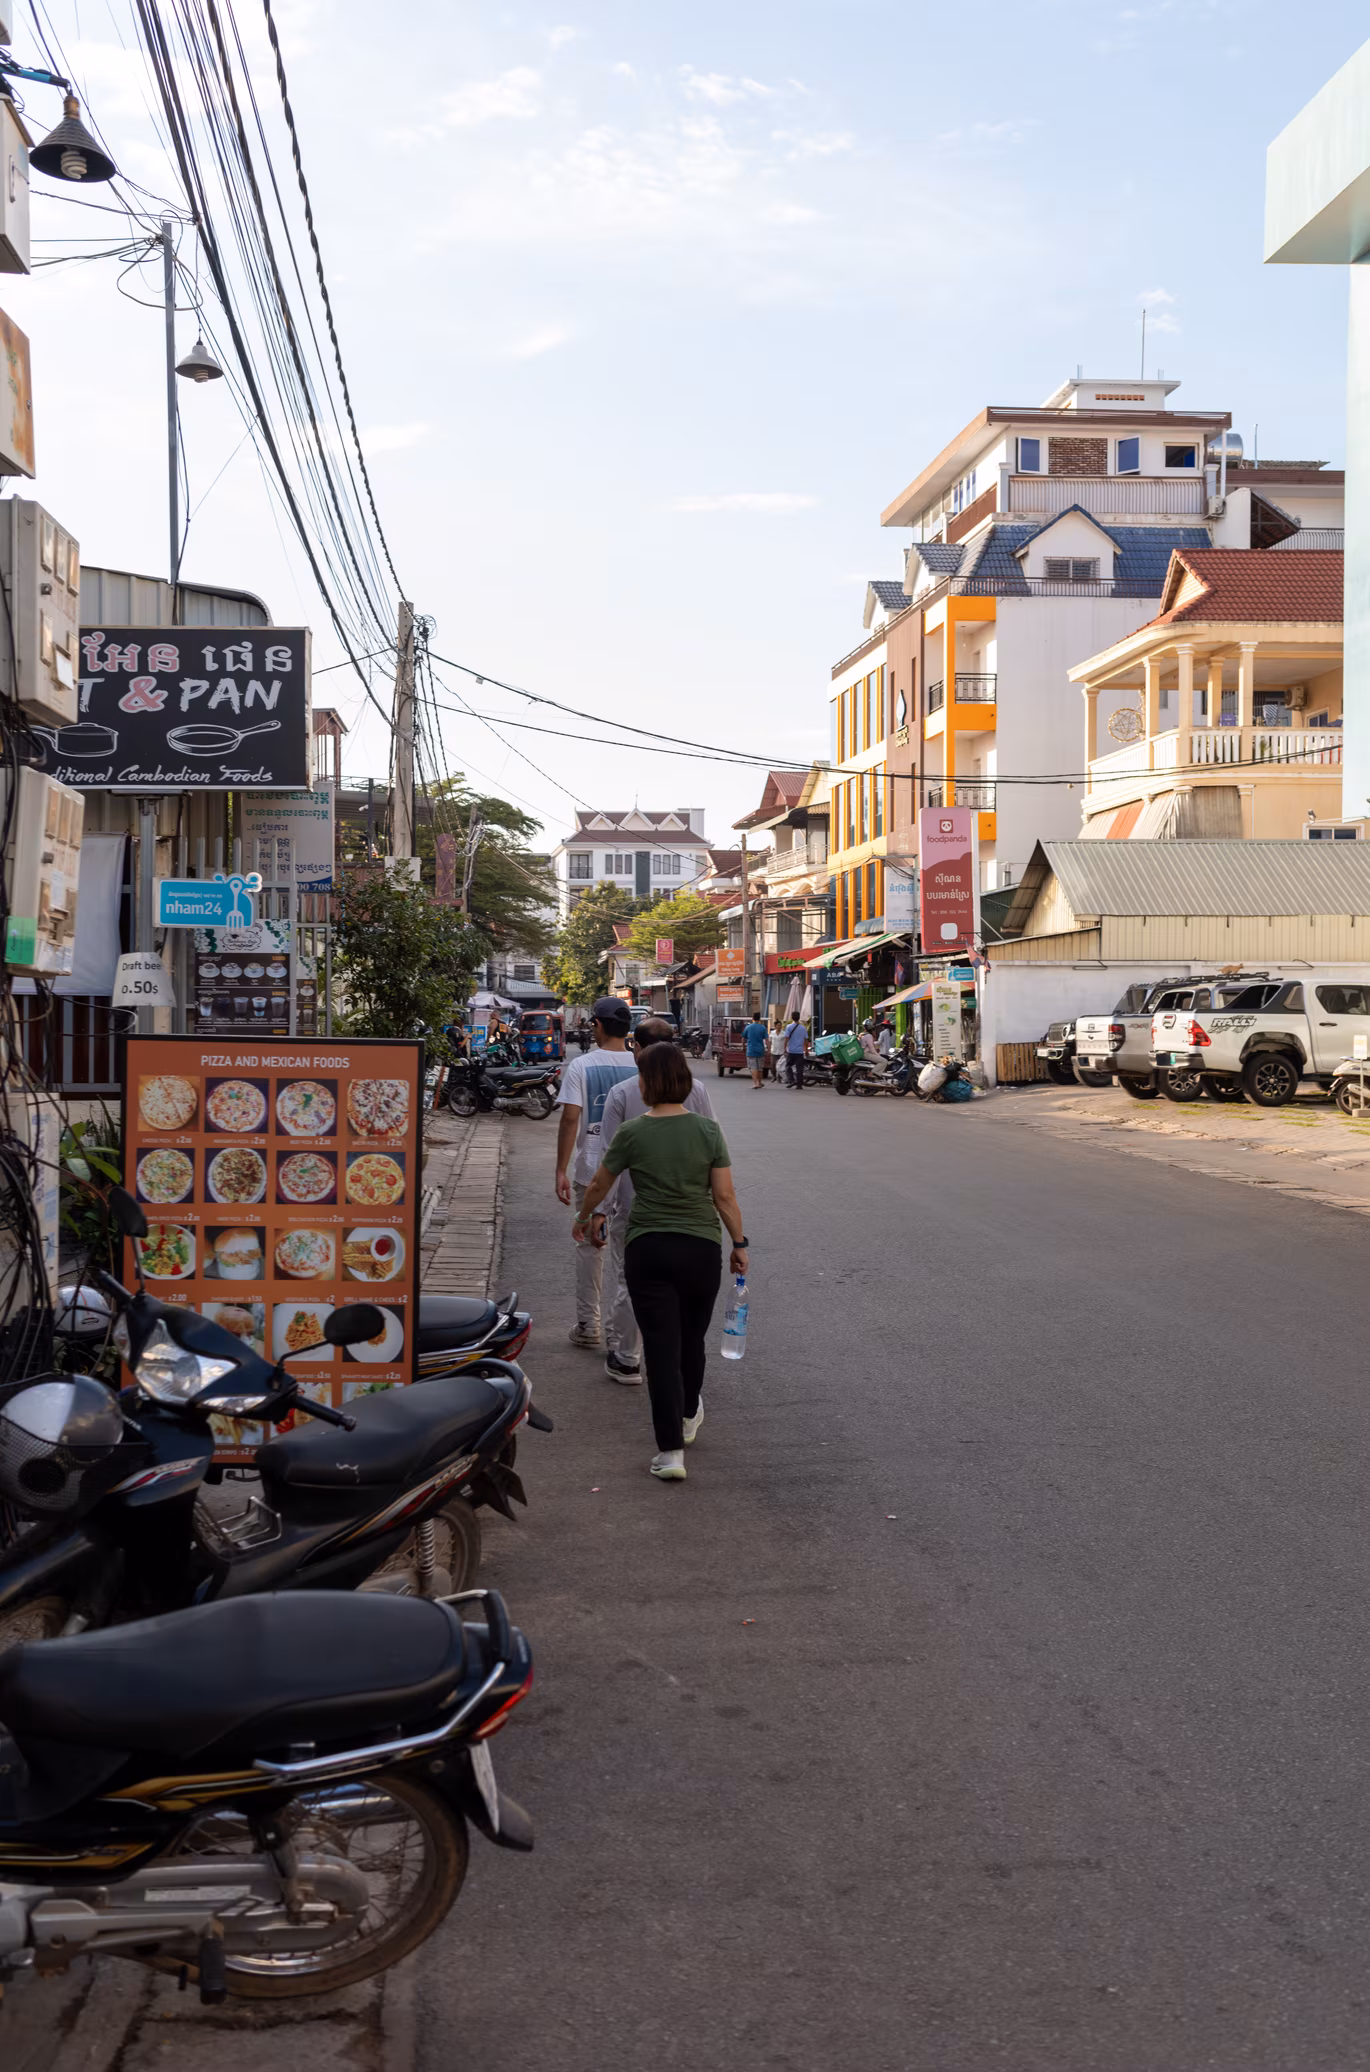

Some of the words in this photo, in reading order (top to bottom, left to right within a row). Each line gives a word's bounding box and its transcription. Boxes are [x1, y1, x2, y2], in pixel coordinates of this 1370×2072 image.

[77, 678, 105, 713] T
[118, 675, 169, 714] &
[179, 677, 283, 715] PAN
[50, 766, 114, 783] ditional
[117, 764, 212, 783] Cambodian
[218, 765, 273, 783] Foods
[926, 835, 968, 845] foodpanda
[312, 882, 331, 892] 708
[165, 900, 223, 916] nham24
[122, 961, 142, 971] Draft
[121, 980, 159, 995] 0.50$
[1211, 1017, 1257, 1028] RALLY
[201, 1055, 232, 1067] PIZZA
[234, 1055, 259, 1067] AND
[261, 1056, 310, 1068] MEXICAN
[313, 1056, 350, 1069] FOODS
